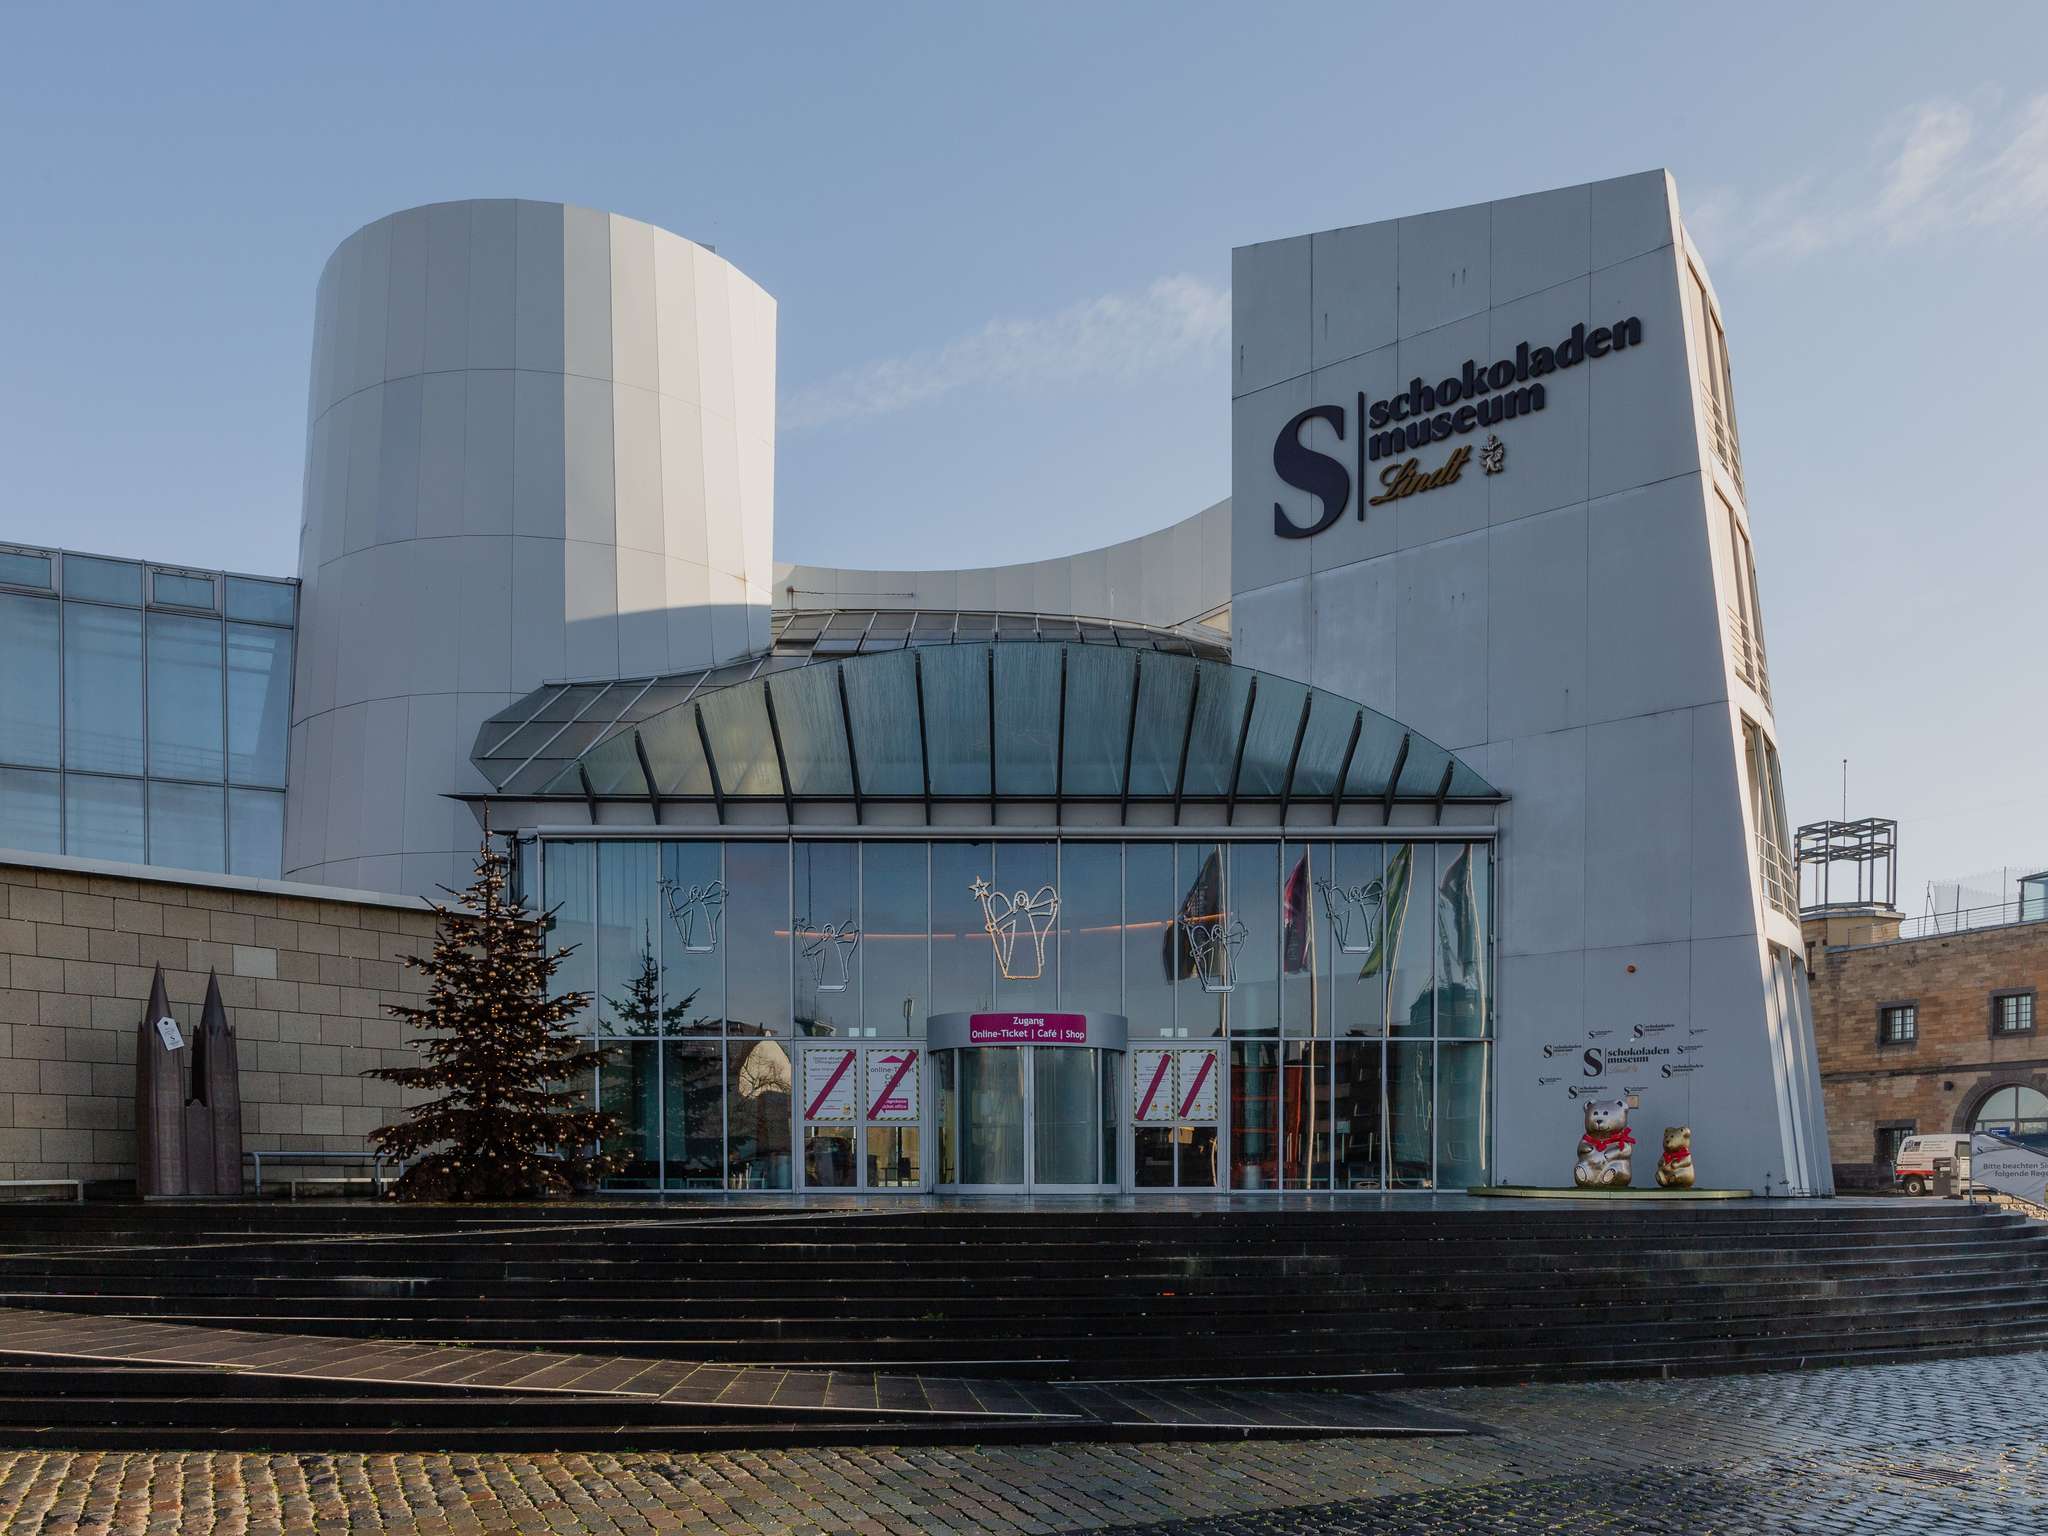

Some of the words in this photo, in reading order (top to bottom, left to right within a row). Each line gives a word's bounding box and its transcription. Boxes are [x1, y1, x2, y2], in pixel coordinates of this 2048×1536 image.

[1368, 315, 1642, 429] schokoladen
[1368, 381, 1546, 461] museum
[1273, 404, 1350, 540] S
[1368, 444, 1472, 506] Lindt
[1012, 1016, 1045, 1027] Zugang
[971, 1029, 1028, 1039] Online-Ticket
[1037, 1028, 1057, 1038] Café
[1065, 1030, 1085, 1040] Shop
[1607, 1046, 1670, 1057] schokoladen
[1607, 1055, 1649, 1064] museum
[2002, 1161, 2039, 1169] beachten
[1994, 1170, 2029, 1179] folgende
